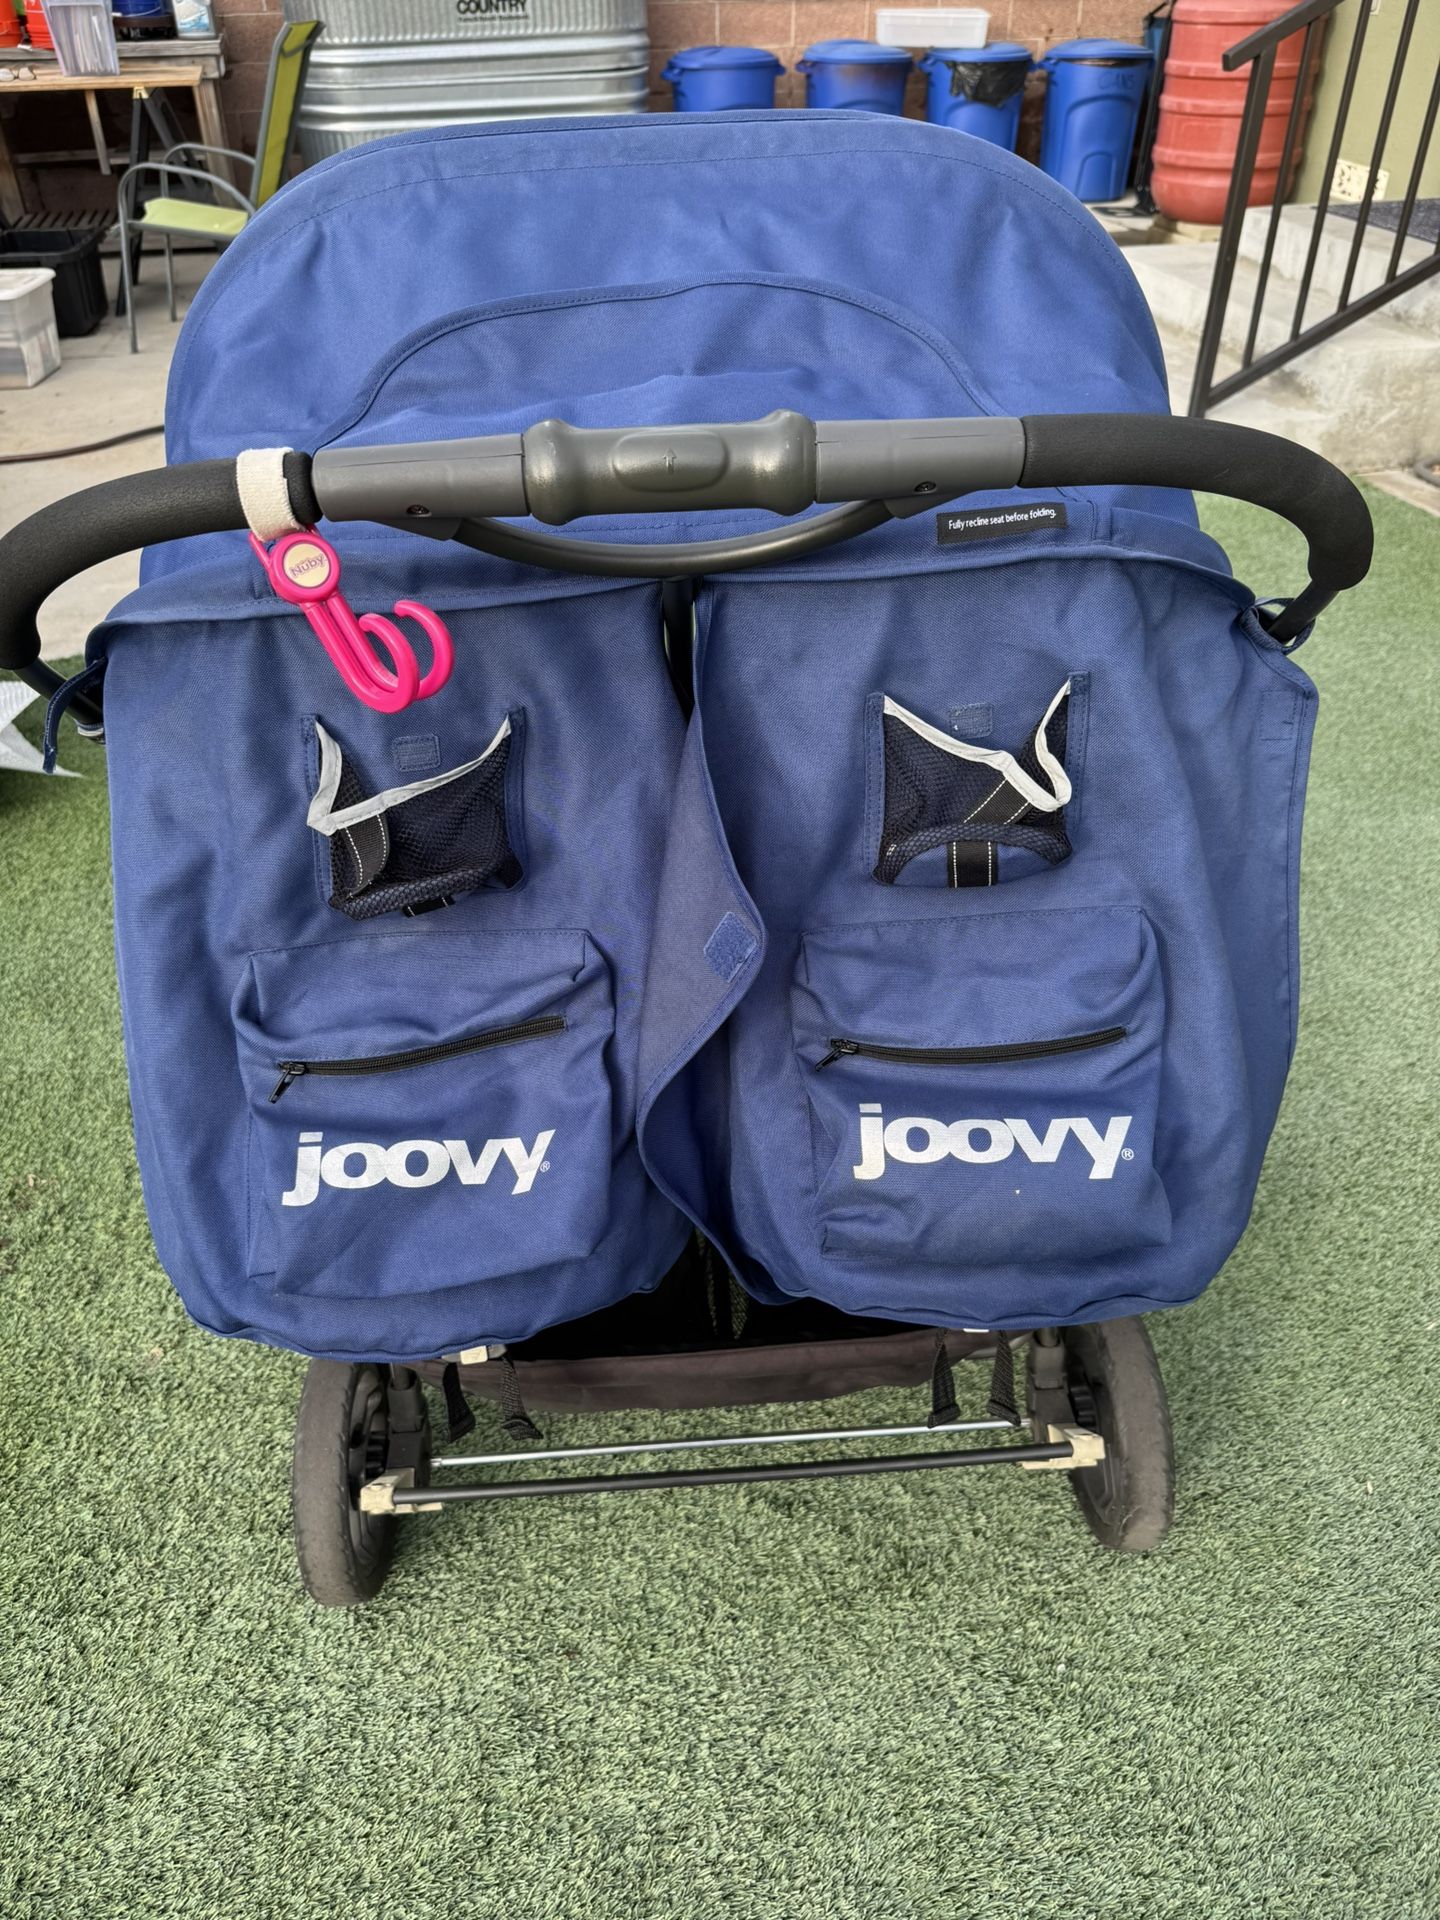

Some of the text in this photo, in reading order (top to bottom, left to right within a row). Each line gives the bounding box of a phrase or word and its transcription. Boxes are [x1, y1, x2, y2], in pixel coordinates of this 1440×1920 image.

[457, 0, 526, 14] COUNTRY
[948, 508, 1056, 531] Fully recline seat before folding.
